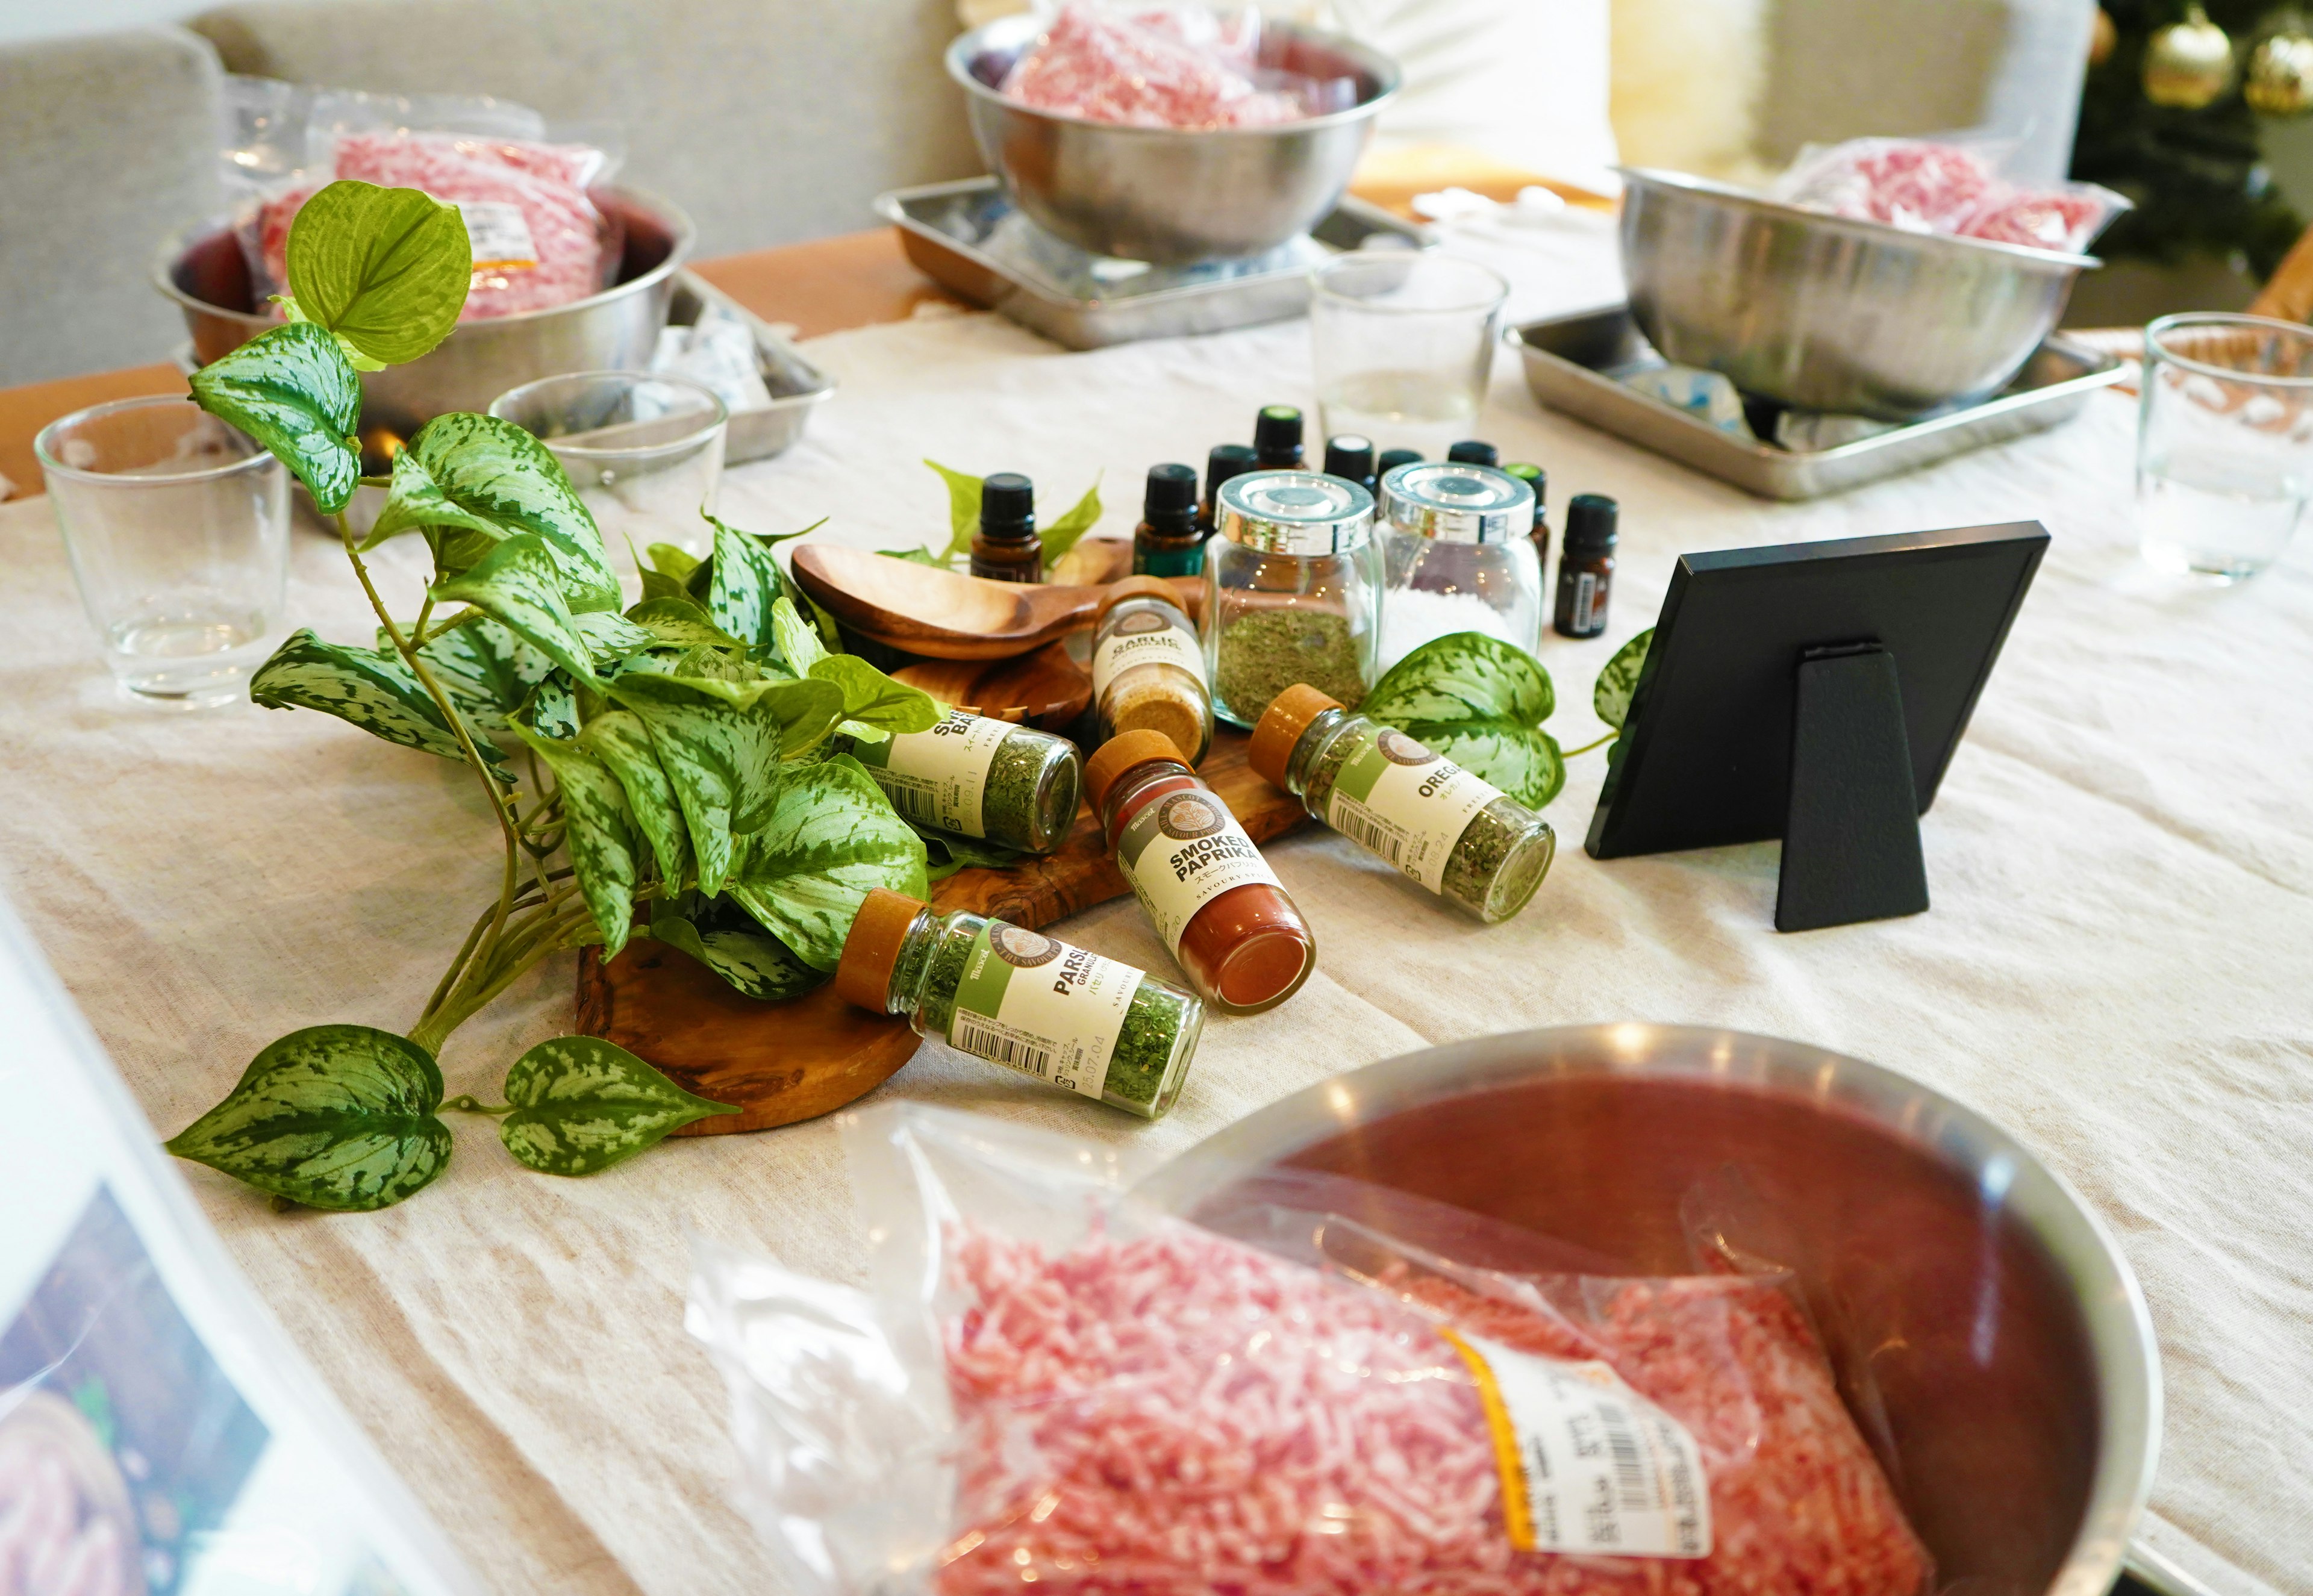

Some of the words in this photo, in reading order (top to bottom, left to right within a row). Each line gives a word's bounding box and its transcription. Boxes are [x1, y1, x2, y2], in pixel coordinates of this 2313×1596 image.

[1114, 637, 1179, 654] GARLIC
[1131, 808, 1156, 832] Mascot
[1167, 827, 1198, 839] SAVOUR
[1170, 835, 1250, 869] SMOKED
[1175, 847, 1260, 883] PAPRIKA
[1196, 874, 1241, 900] SAVOURY
[969, 949, 990, 980] Mascot
[998, 949, 1020, 966] THE
[1021, 951, 1055, 967] SAVOUR
[1082, 1035, 1105, 1089] 25.07.04
